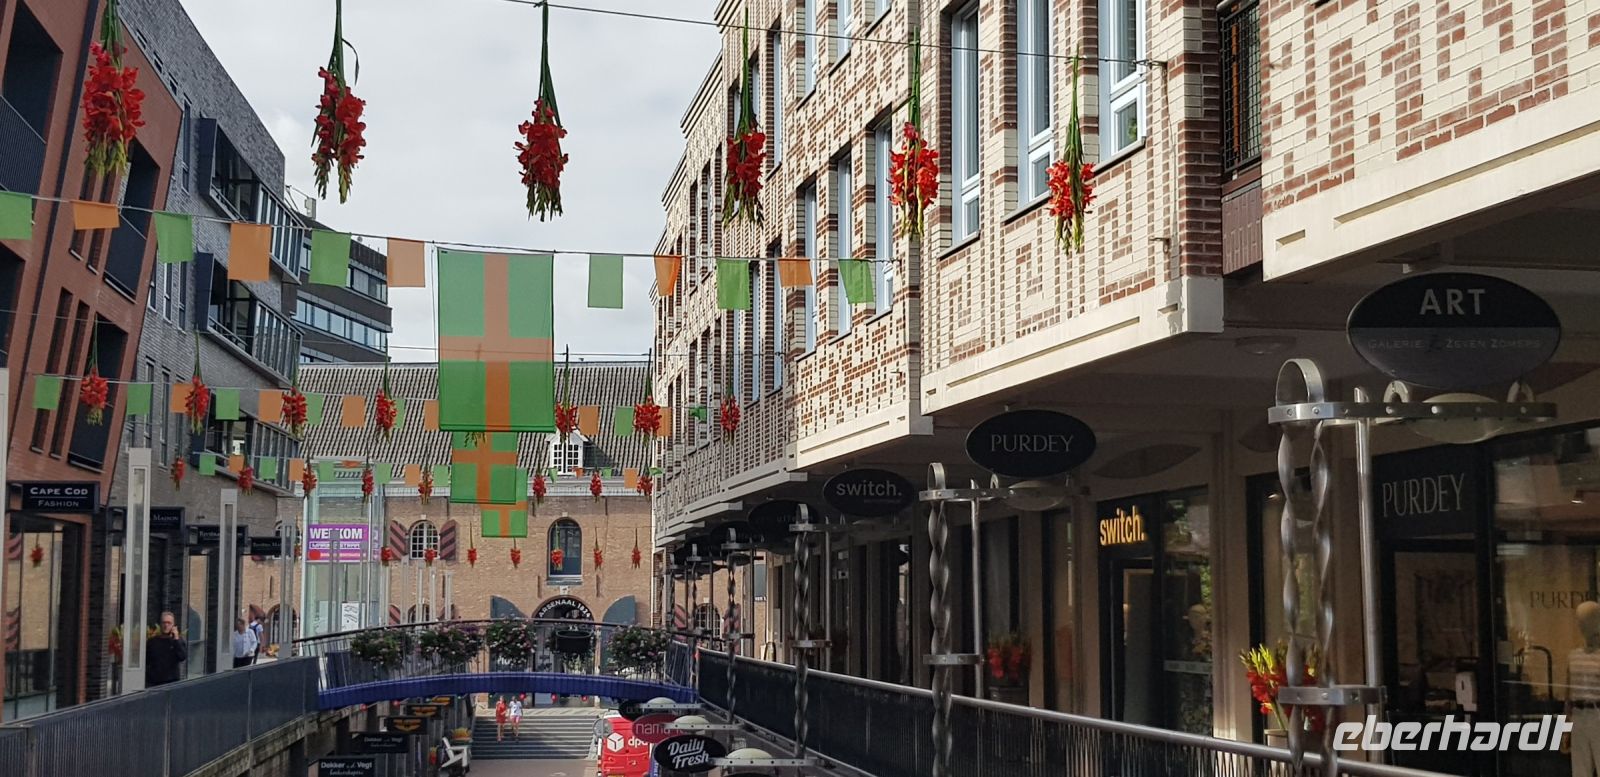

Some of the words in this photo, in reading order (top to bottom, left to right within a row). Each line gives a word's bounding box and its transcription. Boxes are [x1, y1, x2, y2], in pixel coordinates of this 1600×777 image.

[1419, 288, 1485, 315] ART
[991, 434, 1074, 452] PURDEY
[30, 487, 61, 495] CAPE
[64, 487, 88, 495] COD
[836, 479, 903, 496] switch.
[1382, 472, 1465, 518] PURDEY
[1100, 505, 1145, 546] switch.
[668, 739, 704, 756] Daily
[672, 751, 710, 769] Fresh
